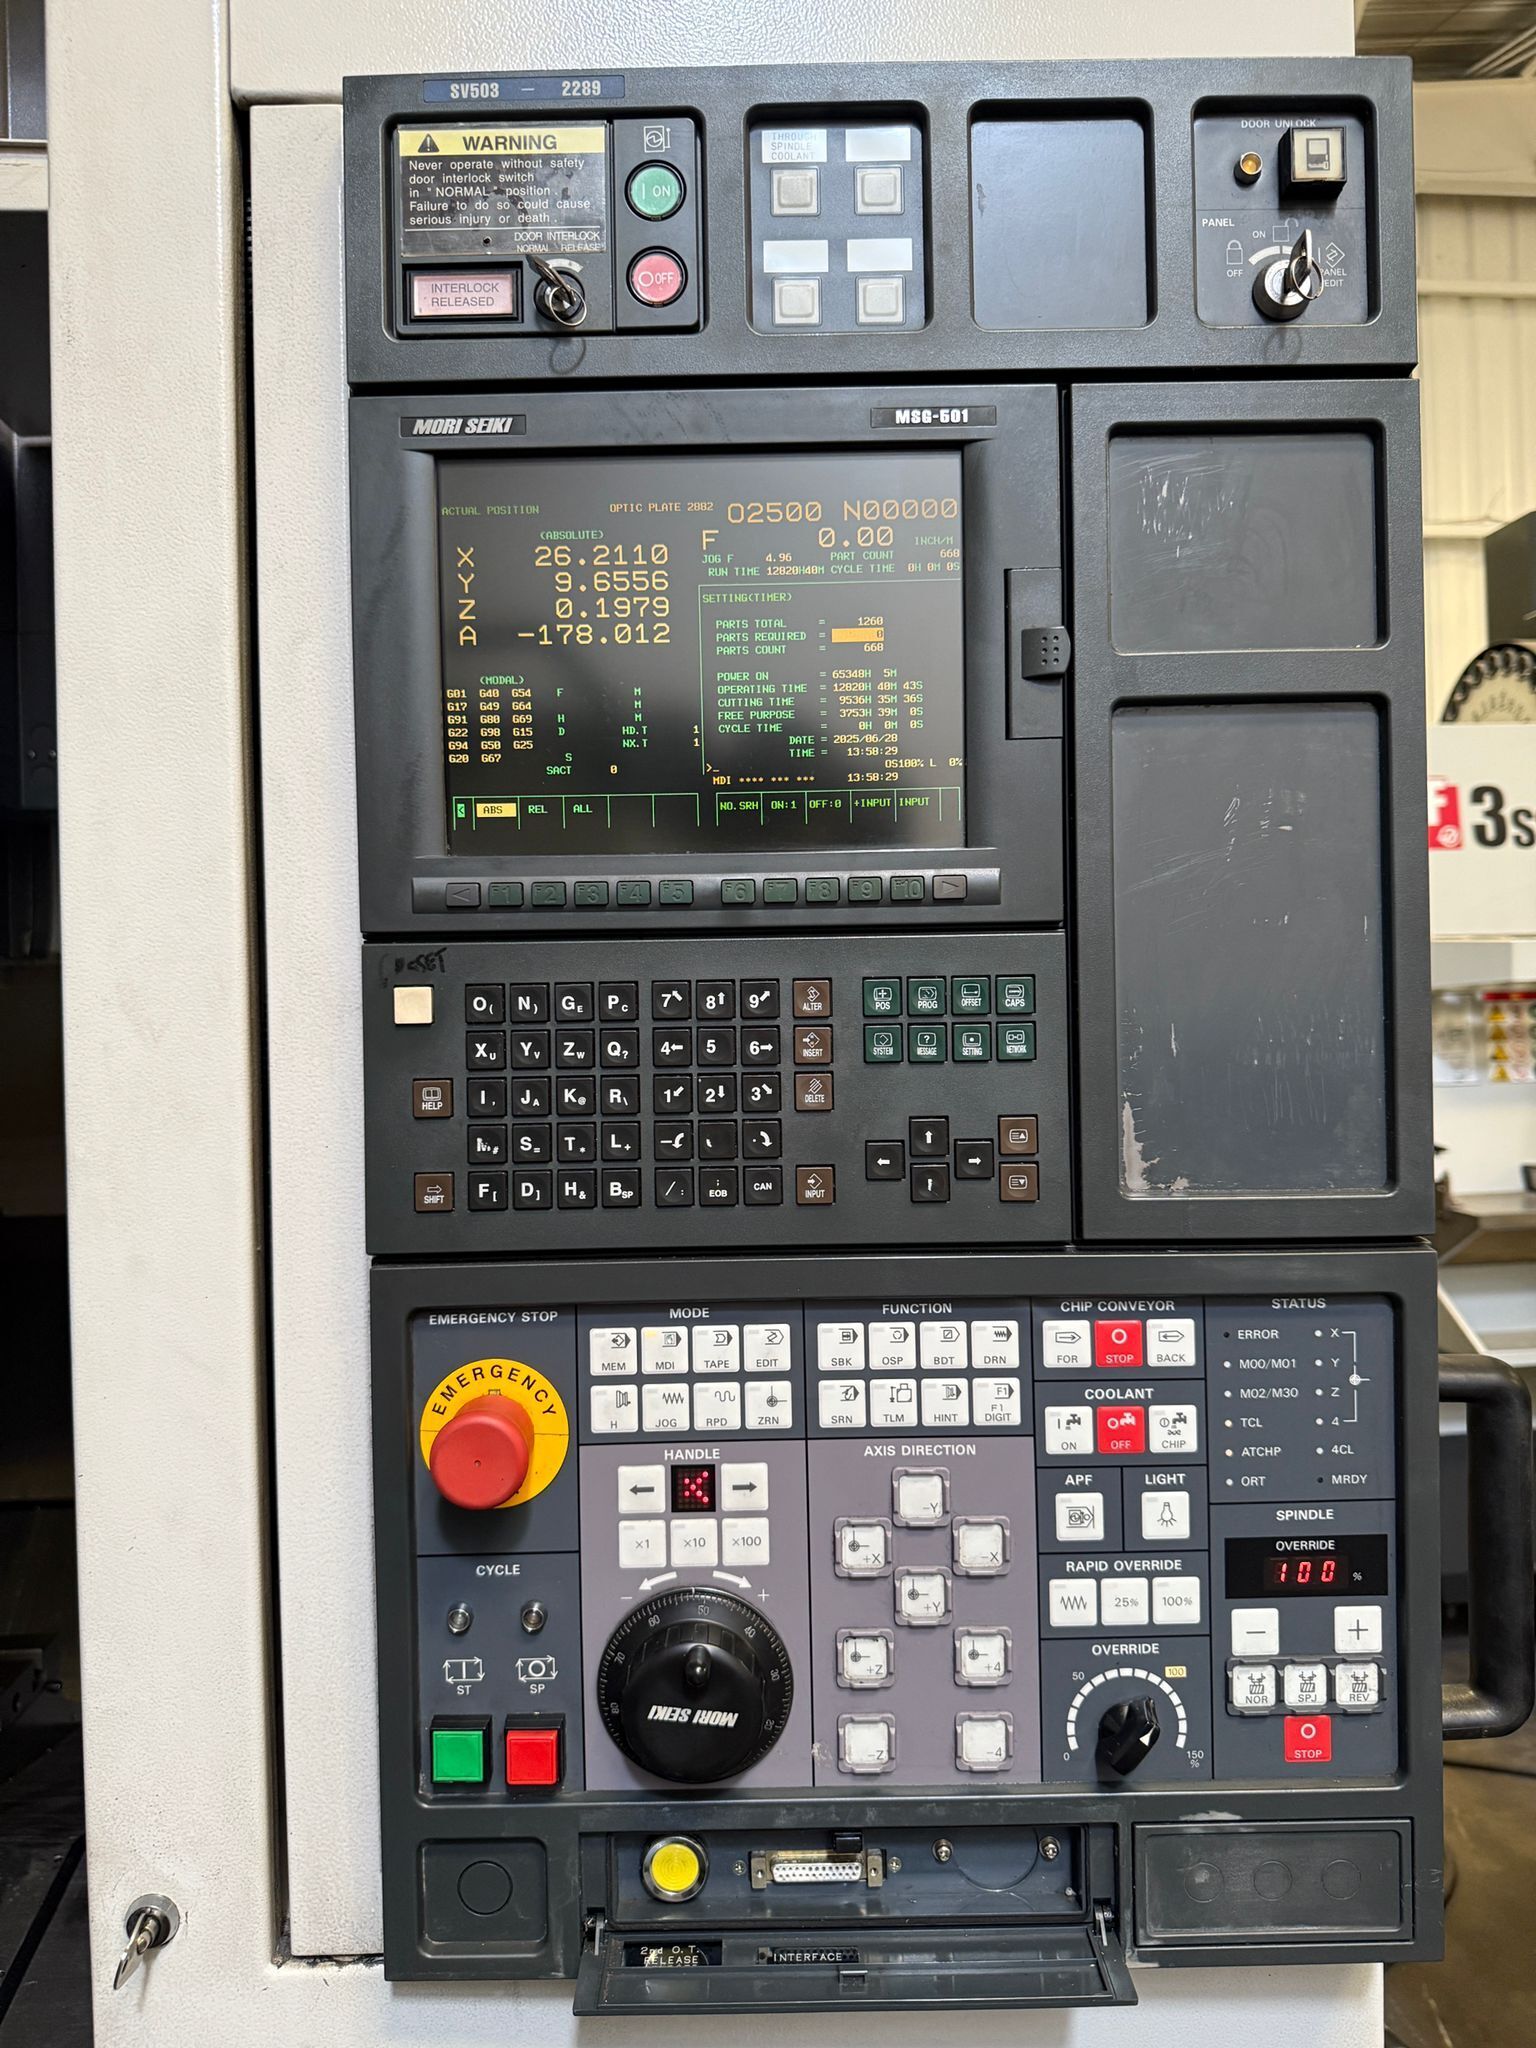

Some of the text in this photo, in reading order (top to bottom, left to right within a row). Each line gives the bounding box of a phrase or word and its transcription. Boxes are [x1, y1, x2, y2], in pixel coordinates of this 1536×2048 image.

[451, 80, 601, 99] SV503 2289
[1241, 120, 1270, 128] DOOR
[463, 135, 557, 151] WARNING
[771, 152, 815, 160] COOLANT
[409, 158, 584, 171] Never operate without safety
[409, 172, 534, 183] door interlock switch
[409, 188, 419, 198] in
[409, 200, 590, 211] Failure to do so could cause
[409, 213, 510, 226] serious injury or
[1202, 219, 1235, 227] PANEL
[514, 231, 600, 241] DOOR INTERLOCK
[561, 243, 600, 251] RELEASE
[1227, 270, 1243, 278] OFF
[431, 283, 499, 294] INTERLOCK
[431, 297, 494, 307] RELEASED
[895, 409, 970, 425] MSG-501
[412, 416, 512, 435] MORI SEIKI
[442, 507, 480, 515] ACTUAL
[487, 505, 540, 514] POSITION
[610, 504, 642, 512] OPTIC
[649, 503, 681, 512] PLATE
[702, 526, 893, 550] F 0.00
[457, 544, 668, 567] X 26.2110
[458, 571, 668, 593] Y 9.6556
[459, 597, 669, 619] Z 0.1979
[460, 623, 670, 646] A -178.012
[716, 632, 806, 642] PARTS REQUIRED
[717, 645, 787, 655] PARTS COUNT
[717, 672, 749, 681] POWER
[717, 684, 807, 694] OPERATING TIME
[718, 697, 794, 707] CUTTING TIME
[718, 710, 795, 720] FREE PURPOSE
[789, 734, 898, 744] DATE 2025/06/28
[790, 746, 898, 757] TIME 13:58:29
[713, 772, 898, 785] MDI 13:58:29
[899, 797, 930, 806] INPUT
[528, 805, 548, 814] REL
[573, 805, 593, 813] ALL
[803, 1003, 822, 1011] ALTER
[876, 1002, 890, 1010] POS
[918, 1001, 938, 1009] PROG
[1005, 999, 1025, 1007] CAPS
[803, 1049, 823, 1057] INSERT
[873, 1047, 893, 1055] SYSTEM
[962, 1048, 982, 1056] SETTING
[805, 1095, 825, 1103] DELETE
[422, 1101, 443, 1111] HELP
[753, 1181, 772, 1191] CAN
[709, 1188, 728, 1198] EOB
[805, 1190, 825, 1198] INPUT
[424, 1194, 445, 1205] SHIFT
[1061, 1300, 1175, 1312] CHIP CONVEYOR
[1271, 1298, 1326, 1309] STATUS
[669, 1307, 710, 1319] MODE
[882, 1303, 952, 1315] FUNCTION
[429, 1311, 558, 1325] EMERGENCY STOP
[1238, 1329, 1279, 1339] ERROR
[756, 1358, 778, 1368] EDIT
[831, 1357, 852, 1367] SBK
[882, 1356, 903, 1366] OSP
[934, 1356, 955, 1365] BDT
[984, 1355, 1006, 1364] DRN
[1057, 1355, 1078, 1364] FOR
[1105, 1354, 1134, 1363] STOP
[1156, 1353, 1186, 1363] BACK
[601, 1361, 626, 1371] MEM
[656, 1361, 675, 1370] MDI
[704, 1359, 730, 1369] TAPE
[1239, 1358, 1296, 1370] M00/M01
[432, 1364, 556, 1416] EMERGENCY
[1085, 1388, 1154, 1400] COOLANT
[1240, 1387, 1298, 1399] M02/M30
[706, 1417, 728, 1427] RPD
[758, 1416, 779, 1425] ZRN
[831, 1414, 852, 1424] SRN
[883, 1413, 905, 1423] TLM
[934, 1413, 958, 1423] HINT
[984, 1412, 1011, 1422] DIGIT
[655, 1418, 678, 1428] JOG
[1240, 1418, 1263, 1428] TCL
[1061, 1441, 1077, 1450] ON
[1110, 1440, 1132, 1449] OFF
[1162, 1440, 1186, 1449] CHIP
[664, 1448, 720, 1460] HANDLE
[864, 1444, 977, 1457] AXIS DIRECTION
[1241, 1447, 1281, 1457] ATCHP
[1331, 1445, 1354, 1455] 4CL
[1065, 1474, 1093, 1486] APF
[1145, 1473, 1186, 1485] LIGHT
[1241, 1476, 1266, 1486] ORT
[1331, 1475, 1368, 1485] MRDY
[1276, 1509, 1334, 1521] SPINDLE
[1276, 1540, 1336, 1551] OVERRIDE
[476, 1564, 520, 1576] CYCLE
[1066, 1560, 1182, 1572] RAPID OVERRIDE
[1115, 1597, 1139, 1607] 25%
[1162, 1596, 1193, 1606] 100%
[1092, 1643, 1160, 1655] OVERRIDE
[457, 1685, 472, 1695] ST
[530, 1684, 545, 1694] SP
[1245, 1695, 1268, 1704] NOR
[1298, 1694, 1317, 1703] SPJ
[1349, 1693, 1370, 1702] REV
[647, 1705, 738, 1727] MORI SEIKI
[1187, 1750, 1204, 1760] 150
[1294, 1749, 1323, 1759] STOP
[644, 1956, 698, 1964] RELEASE
[774, 1953, 842, 1962] INTERFACE
